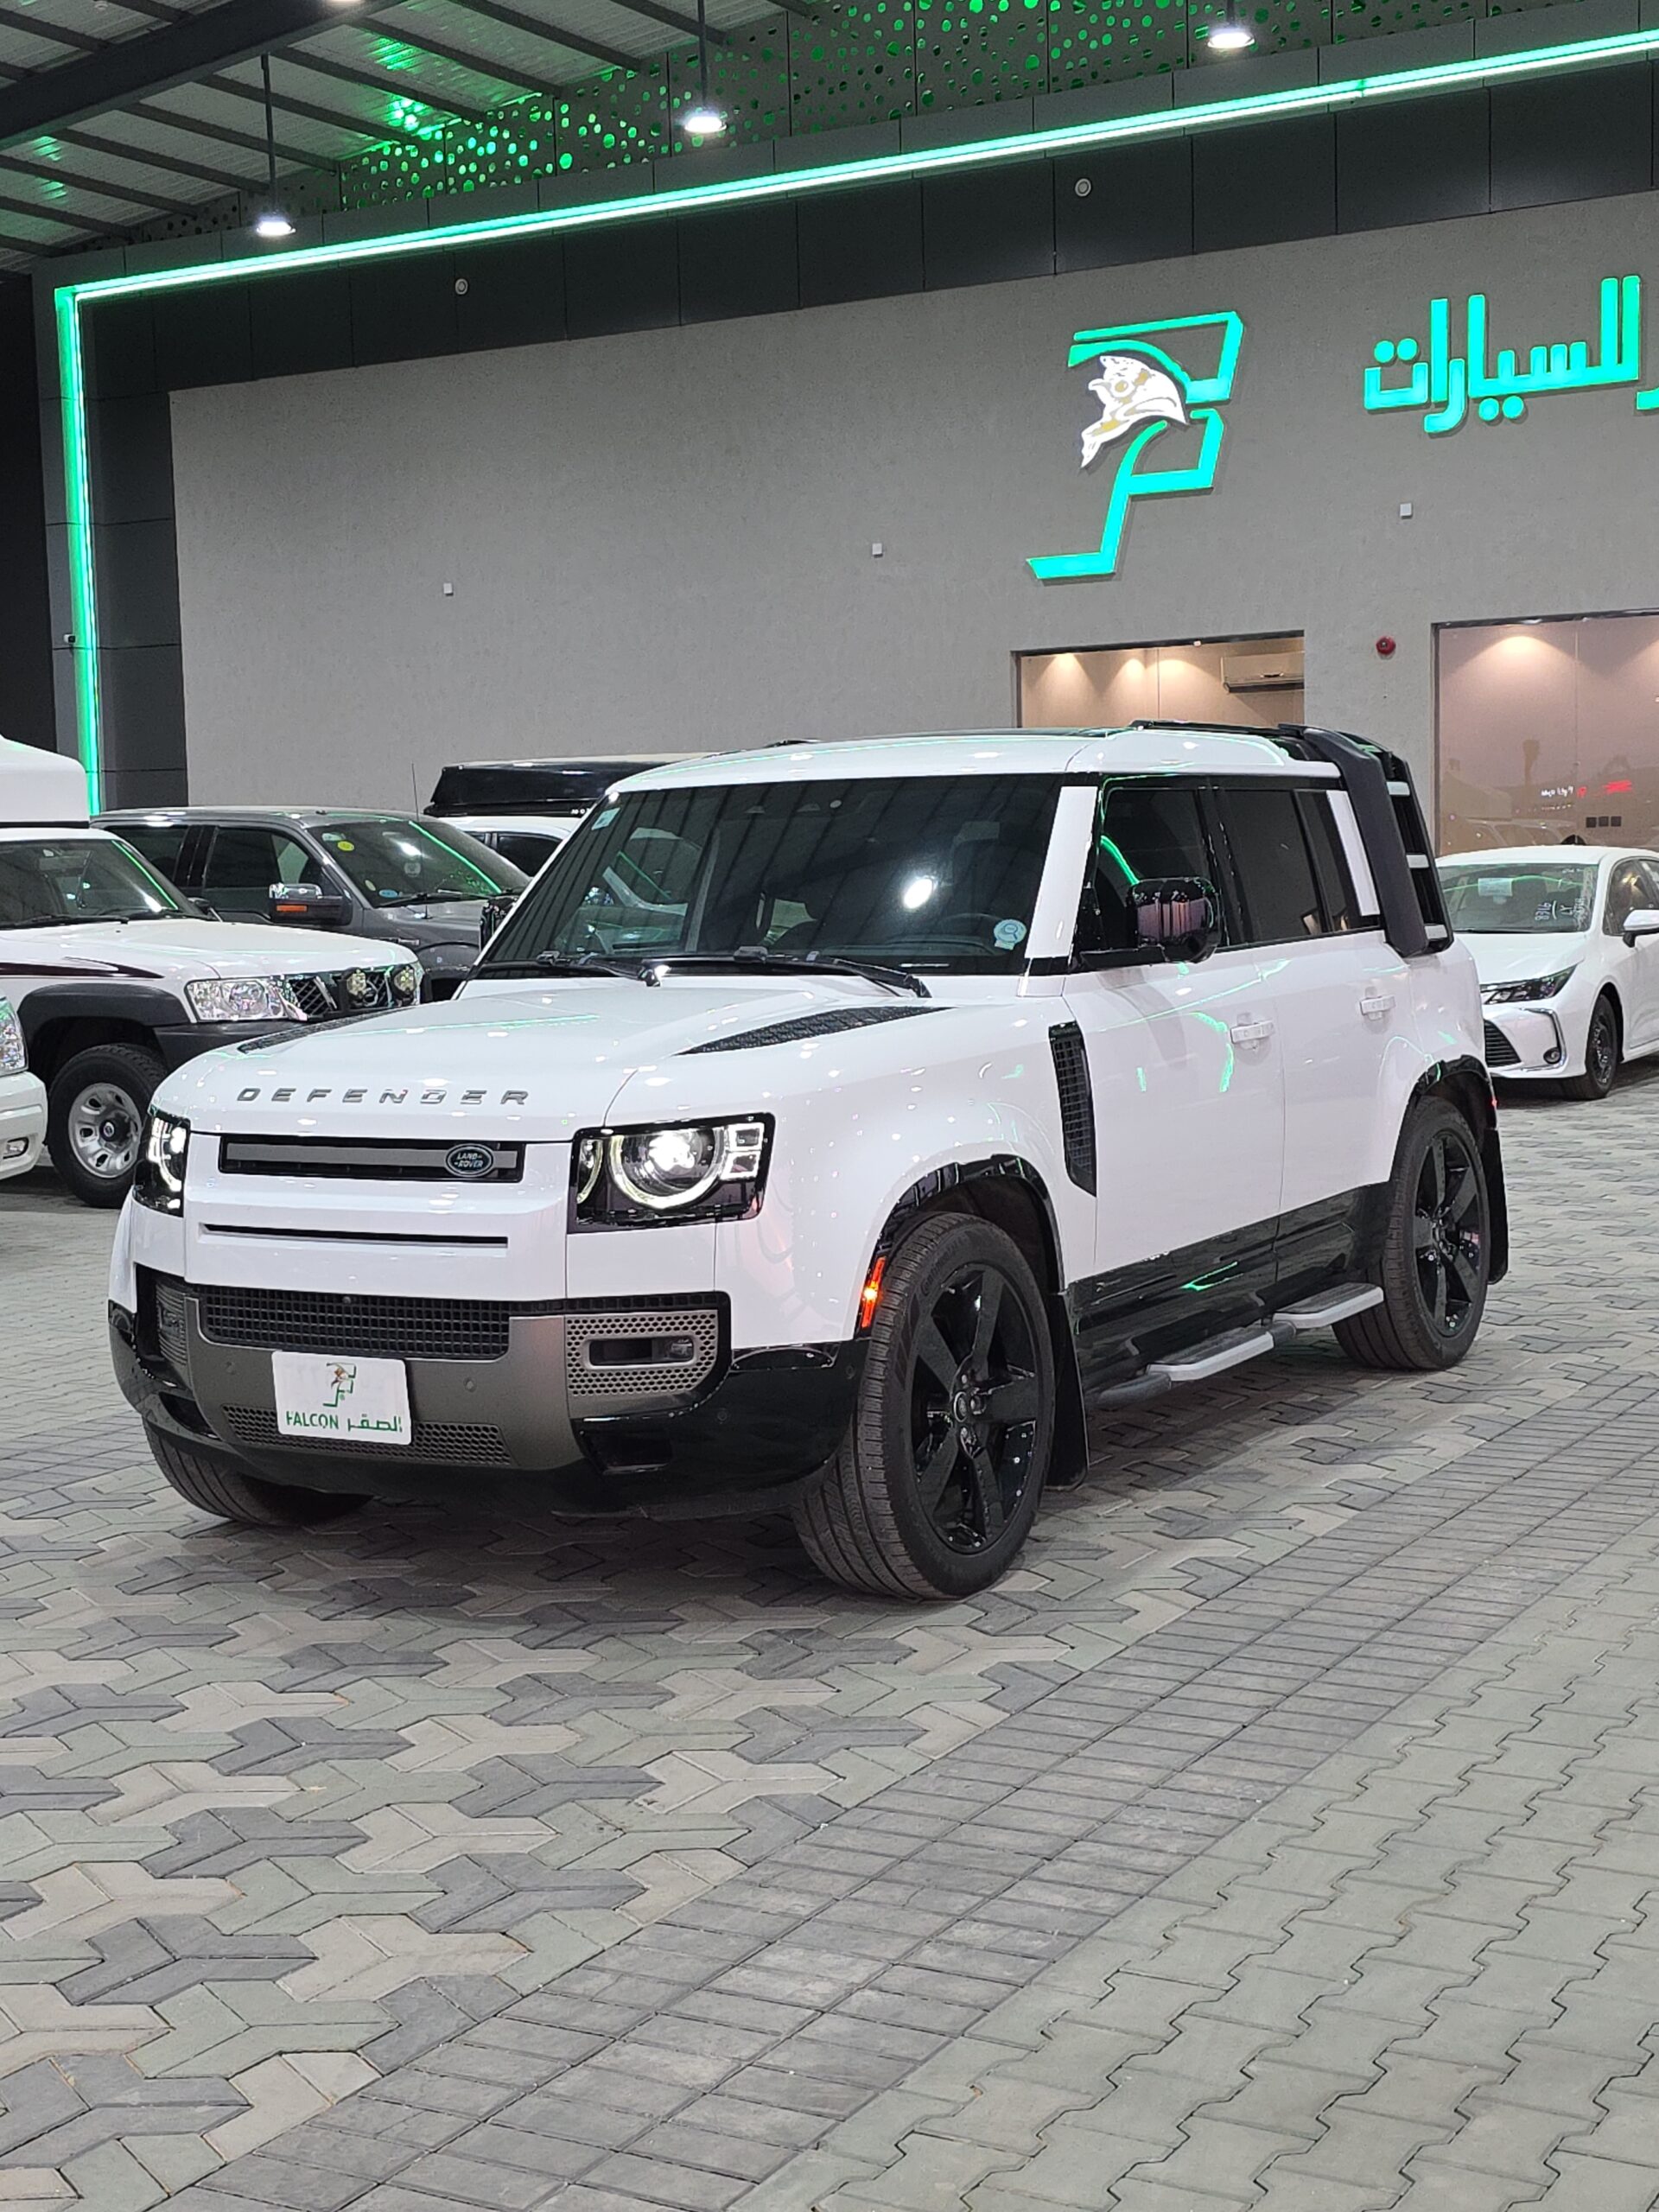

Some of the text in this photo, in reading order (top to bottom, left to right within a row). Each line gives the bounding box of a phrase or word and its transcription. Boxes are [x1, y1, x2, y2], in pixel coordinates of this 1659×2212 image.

[1364, 275, 1641, 433] للسيارات
[236, 1087, 529, 1105] DEFENDER
[456, 1152, 478, 1160] LAND
[458, 1160, 484, 1168] ROVER
[285, 1410, 403, 1433] FALCON الصقر
